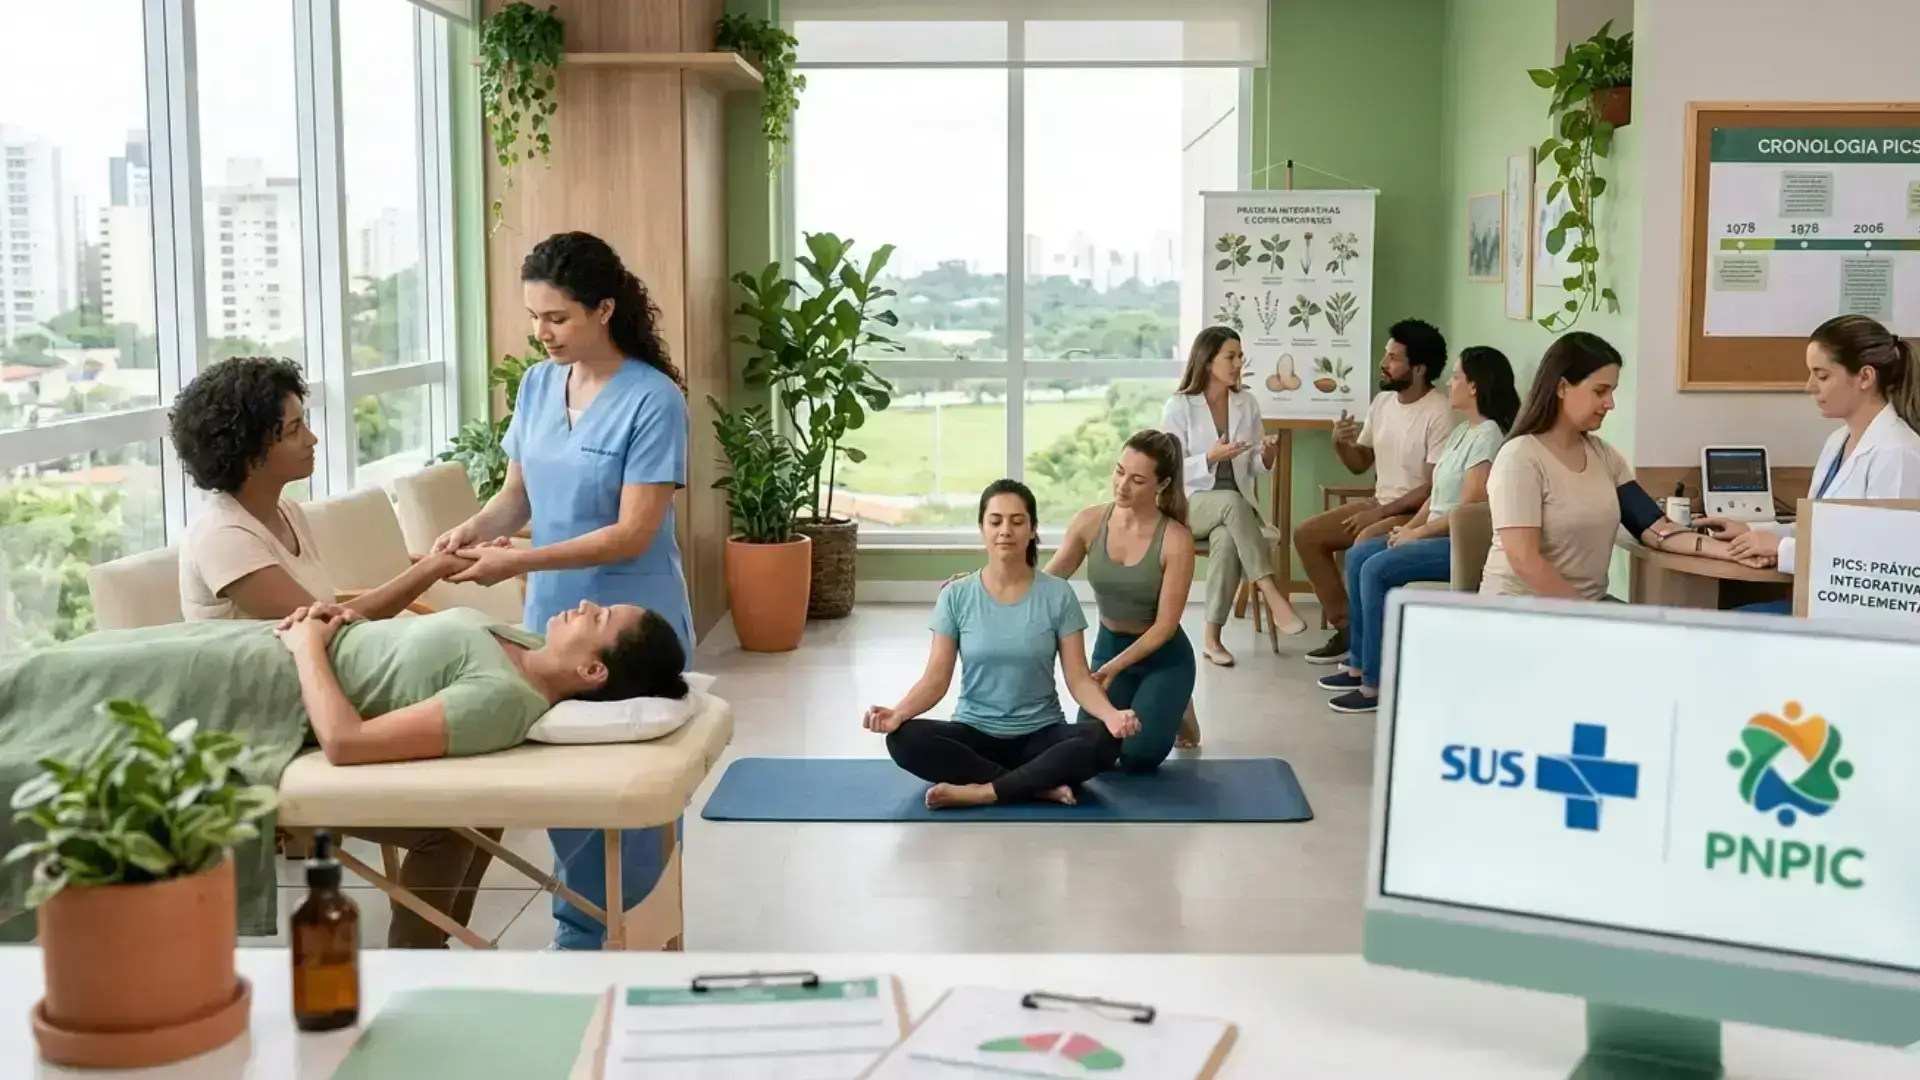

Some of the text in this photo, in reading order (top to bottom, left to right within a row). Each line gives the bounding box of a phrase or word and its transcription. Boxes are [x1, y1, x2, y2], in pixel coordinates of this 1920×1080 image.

[1758, 139, 1920, 154] CRONOLOGIA PICS
[1853, 222, 1884, 234] 2006
[1832, 557, 1867, 572] PICS:
[1441, 744, 1525, 787] SUS
[1705, 831, 1866, 889] PNPIC
